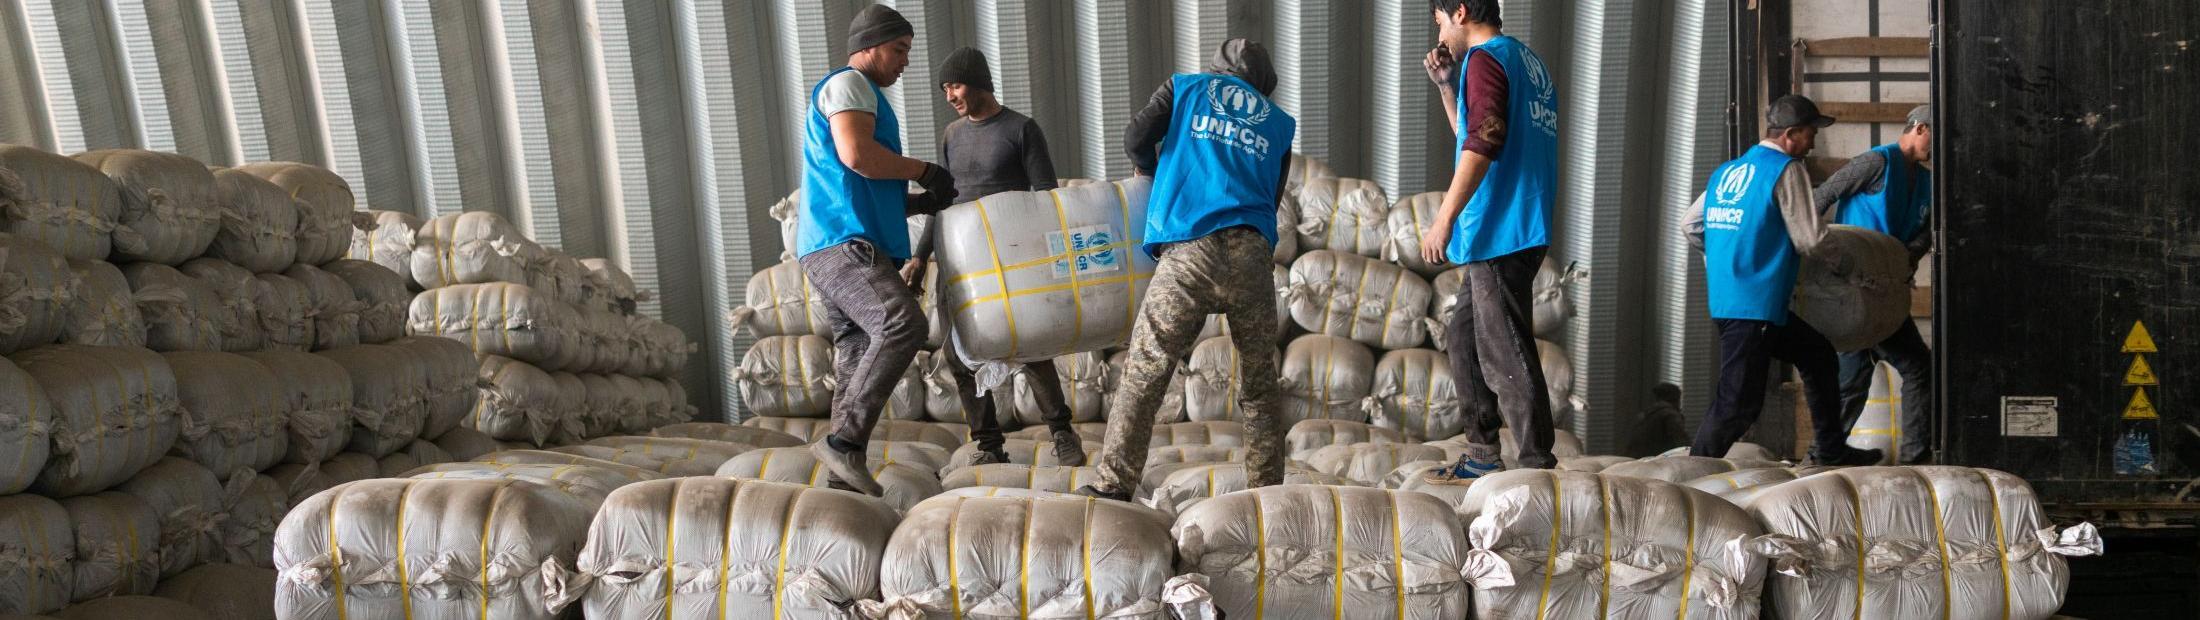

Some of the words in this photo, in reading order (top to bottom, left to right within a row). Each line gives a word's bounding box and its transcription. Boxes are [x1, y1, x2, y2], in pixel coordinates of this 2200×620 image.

[1191, 114, 1270, 154] UNHCR
[1706, 206, 1744, 224] UNHCR
[1073, 232, 1088, 271] UNCR
